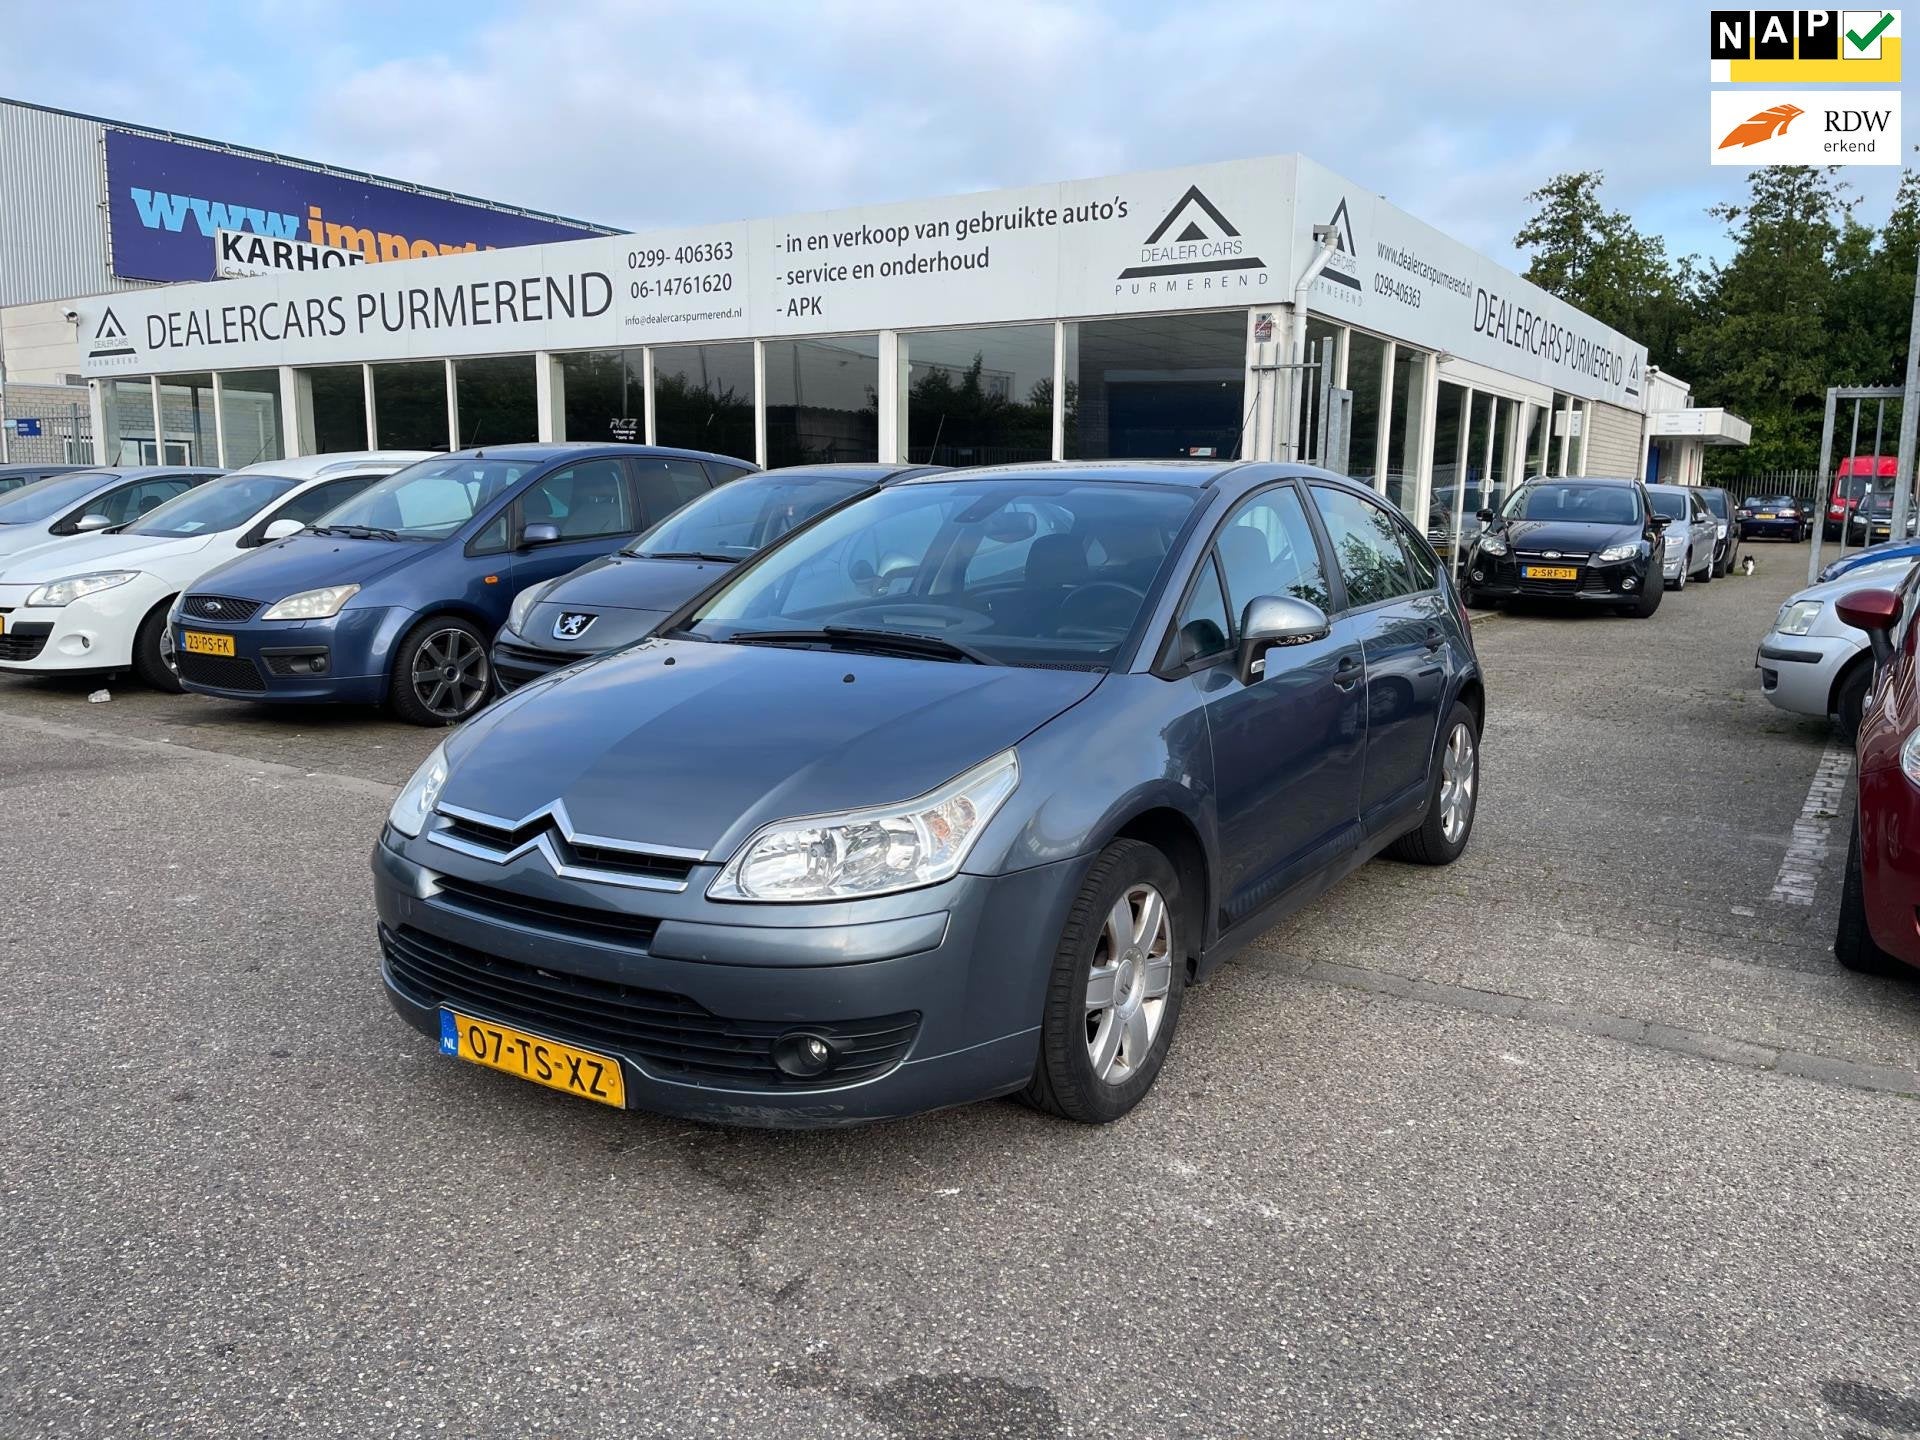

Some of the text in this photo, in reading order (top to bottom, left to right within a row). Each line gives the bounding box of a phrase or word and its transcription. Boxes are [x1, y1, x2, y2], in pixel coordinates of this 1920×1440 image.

[786, 234, 802, 253] in
[807, 234, 829, 251] en
[833, 225, 910, 247] verkoop
[914, 221, 949, 240] van
[955, 205, 1058, 241] gebruikte
[1062, 195, 1128, 225] auto's
[674, 241, 733, 264] 406363
[1141, 240, 1243, 263] DEALER CARS
[787, 263, 848, 286] service
[852, 263, 874, 280] en
[880, 246, 989, 277] onderhoud
[1377, 241, 1473, 299] www.dealercarspurmerend.nl
[630, 273, 732, 299] 06-14761620
[1115, 273, 1268, 296] PURMEREND
[1374, 272, 1421, 309] 0299-406363
[147, 271, 613, 350] DEALERCARS PURMEREND
[625, 307, 742, 326] info@dealercarspurmerend.nl
[787, 296, 822, 317] APK
[1474, 288, 1623, 386] DEALERCARS PURMEREND
[1531, 568, 1572, 578] 2-SRF-31
[188, 634, 230, 653] 23-PS-FK
[443, 1036, 457, 1050] NL
[468, 1025, 608, 1098] 07-TS-XZ
